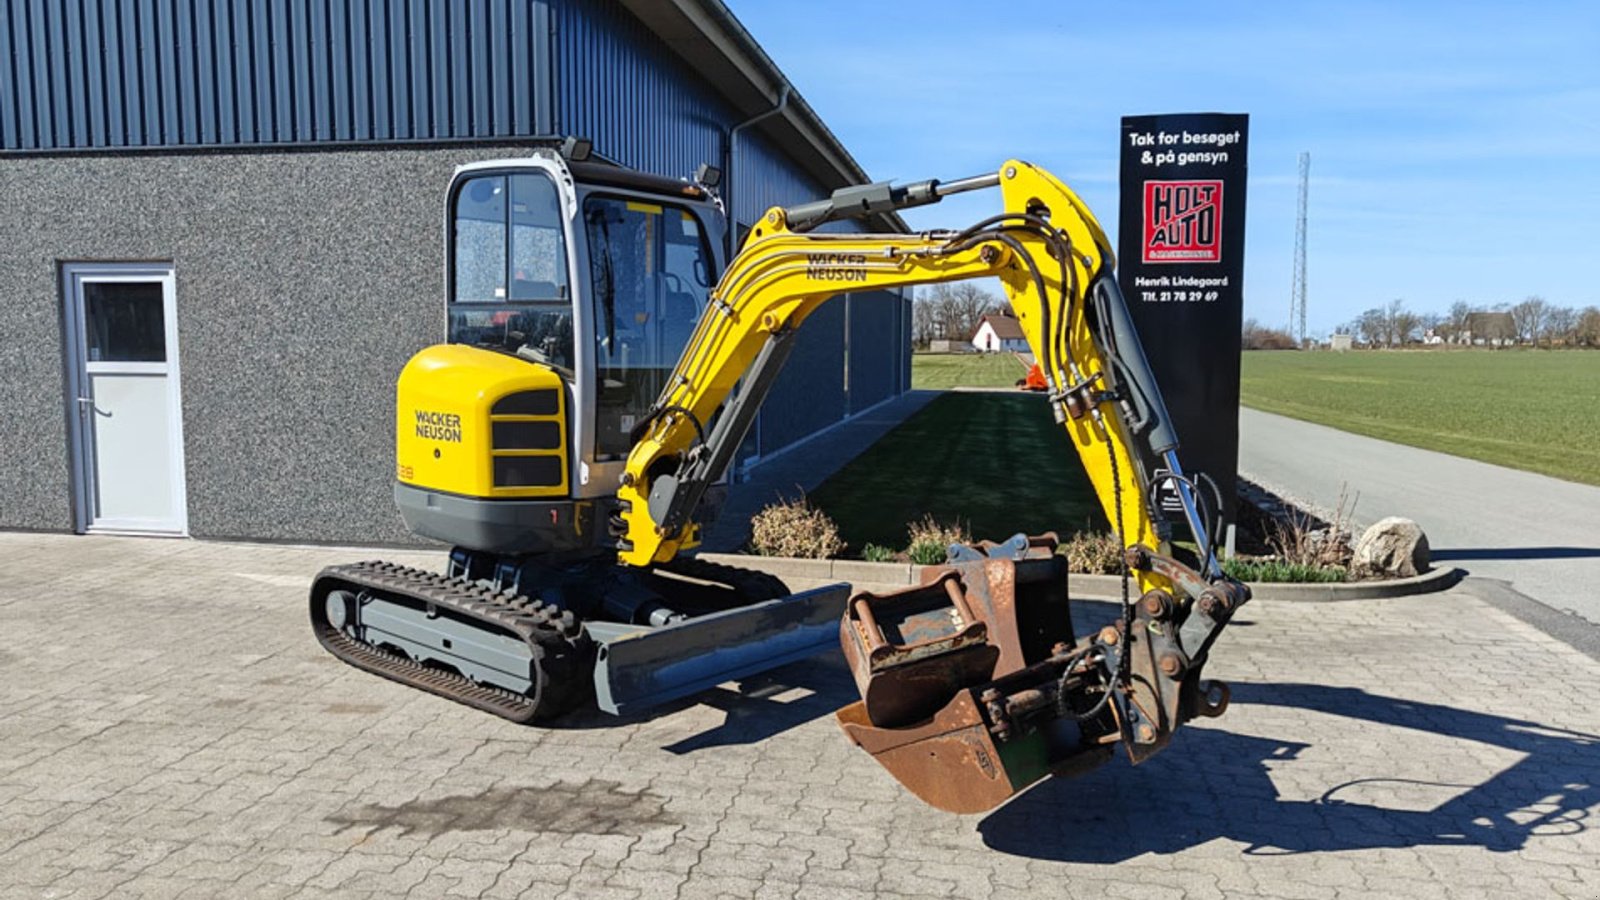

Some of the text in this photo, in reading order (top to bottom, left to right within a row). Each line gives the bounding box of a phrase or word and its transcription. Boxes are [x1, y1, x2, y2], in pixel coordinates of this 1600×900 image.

[1129, 130, 1240, 146] Tak for besøget
[1141, 150, 1228, 166] & på gensyn
[1153, 185, 1216, 227] HOLT
[1150, 205, 1215, 246] AUTO
[807, 268, 867, 281] NEUSON
[1135, 276, 1228, 288] Henrik Lindegaard
[1141, 291, 1219, 302] Tlf. 21 78 29 69
[415, 410, 461, 428] WACKER
[415, 425, 461, 442] NEUSON
